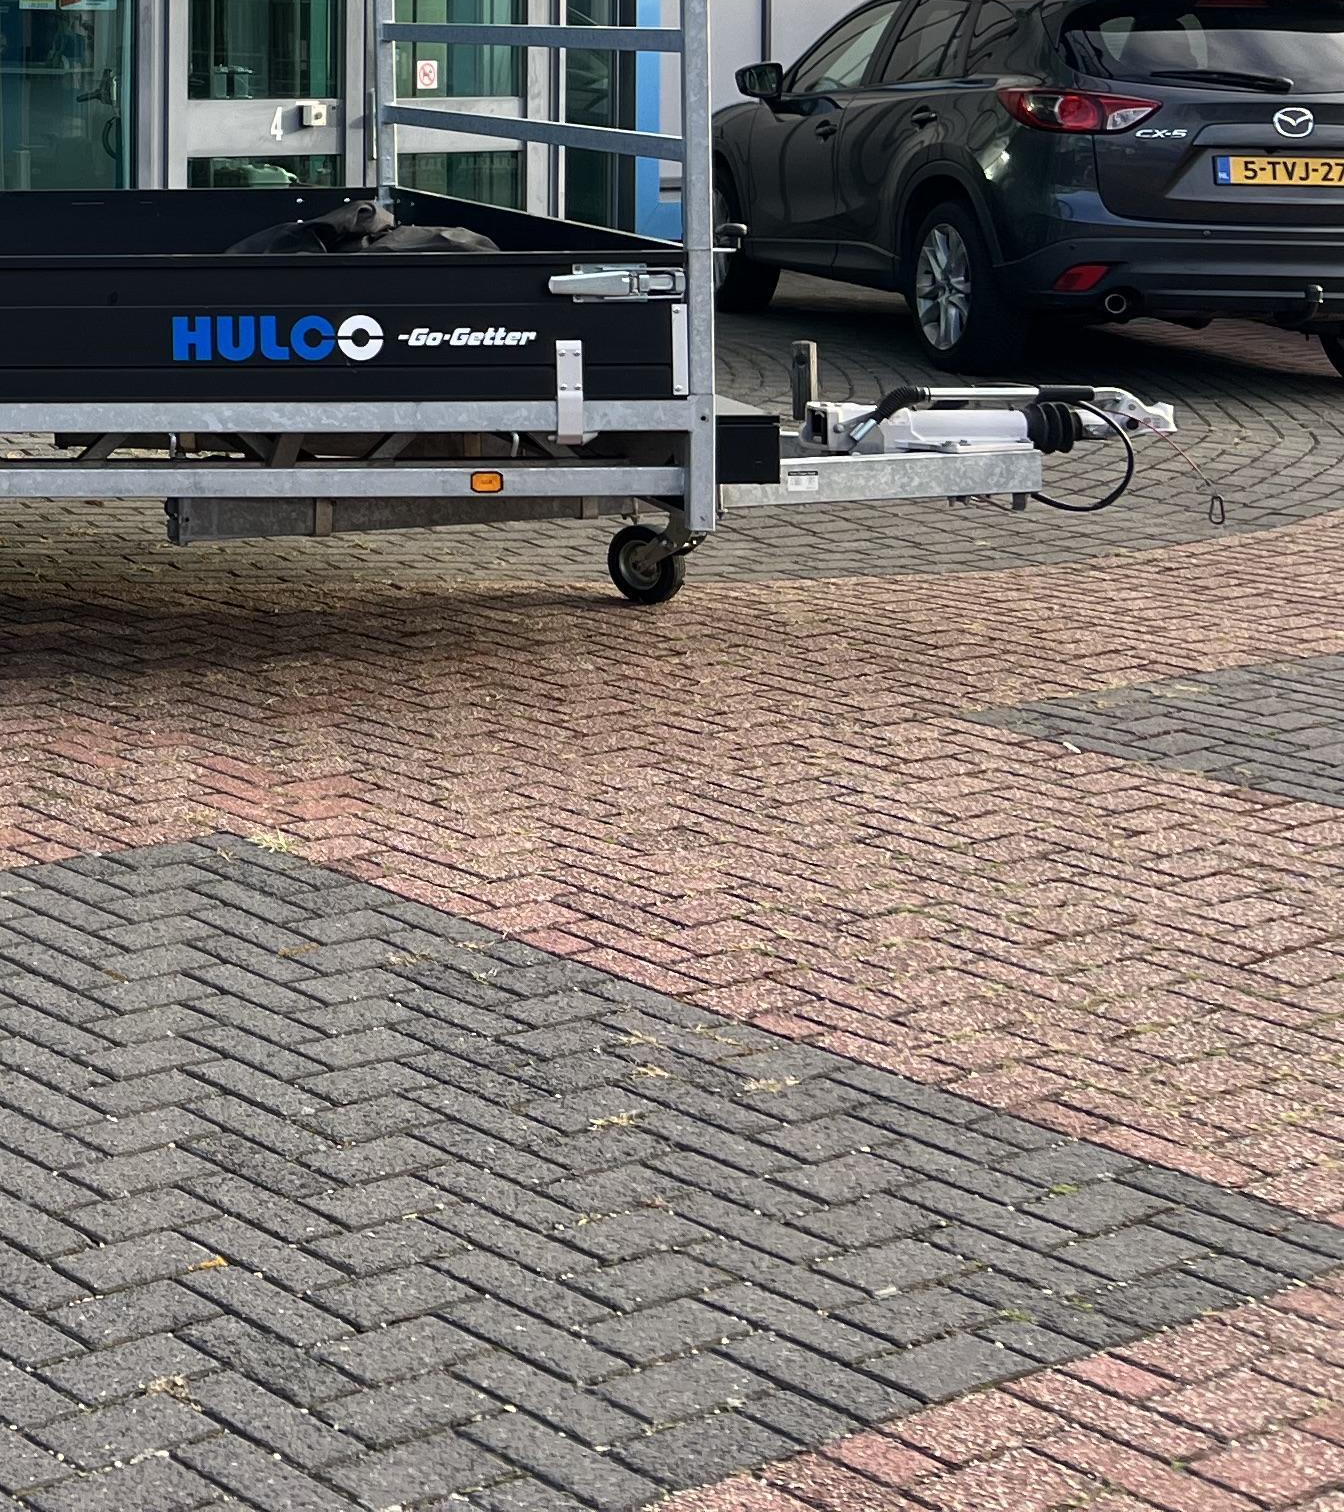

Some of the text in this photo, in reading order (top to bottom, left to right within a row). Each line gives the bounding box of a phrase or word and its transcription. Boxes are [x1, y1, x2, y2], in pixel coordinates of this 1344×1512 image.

[270, 106, 284, 141] 4
[1135, 129, 1188, 138] CX-5
[172, 314, 384, 361] HULCO
